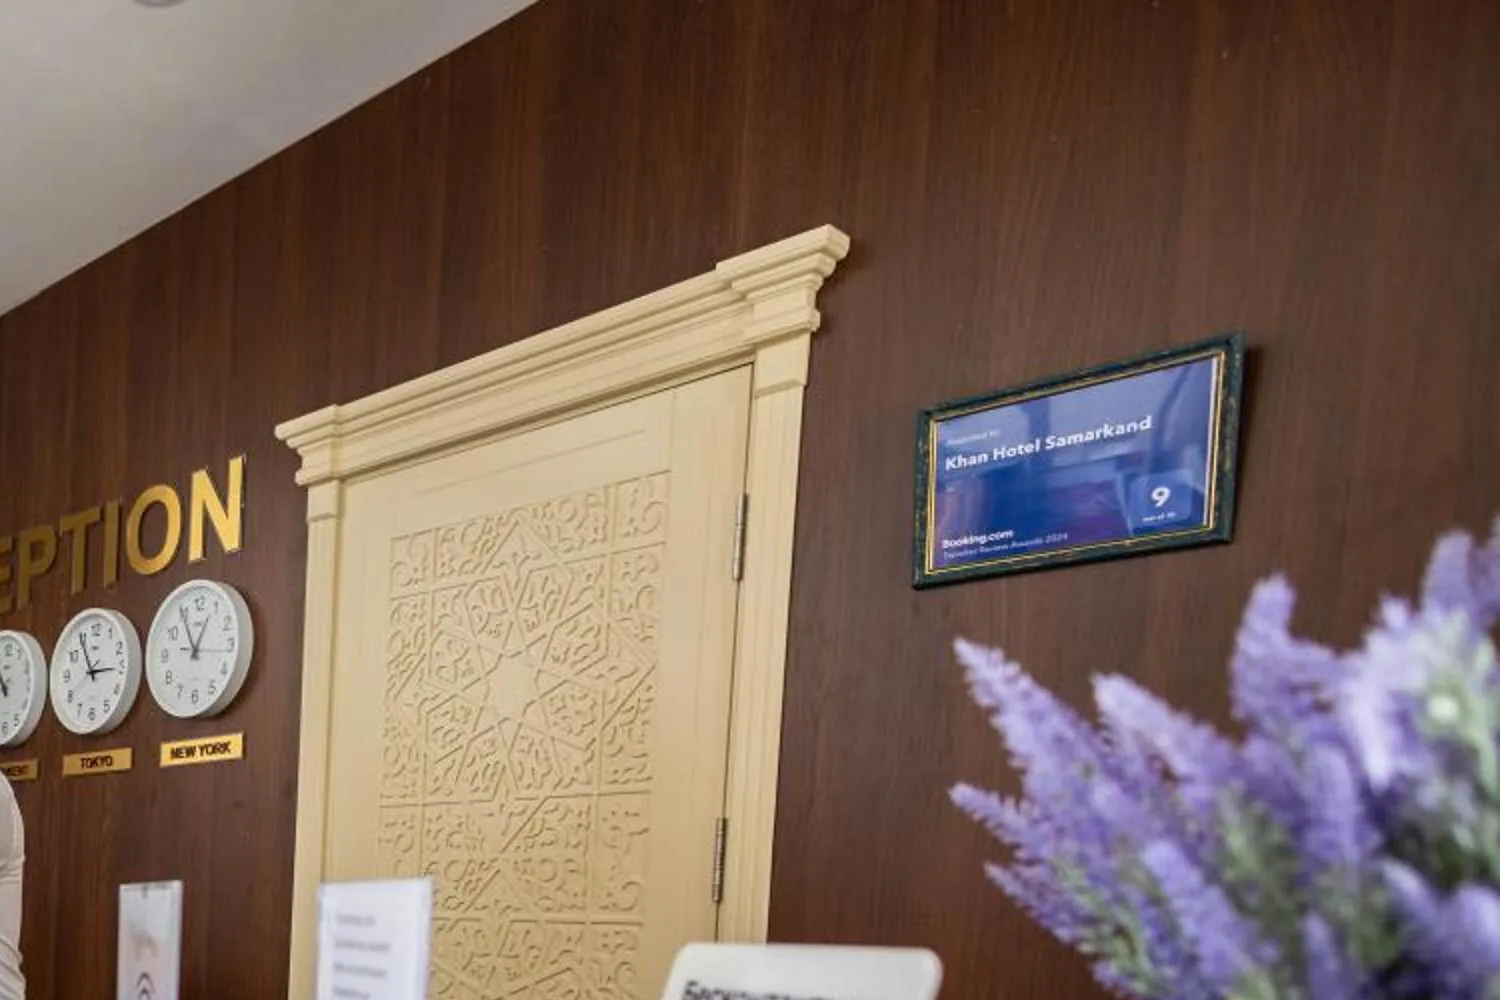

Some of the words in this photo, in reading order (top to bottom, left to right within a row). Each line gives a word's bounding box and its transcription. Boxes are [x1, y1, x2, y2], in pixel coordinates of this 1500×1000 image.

[945, 453, 988, 471] Khan
[992, 437, 1040, 461] Hotel
[1045, 415, 1152, 450] Samarkand
[1151, 486, 1171, 508] 9
[942, 529, 1014, 549] Booking.com
[165, 670, 173, 684] 8
[191, 689, 199, 704] 6
[170, 744, 197, 760] NEW
[198, 740, 231, 757] YORK
[80, 755, 113, 769] TOKYO
